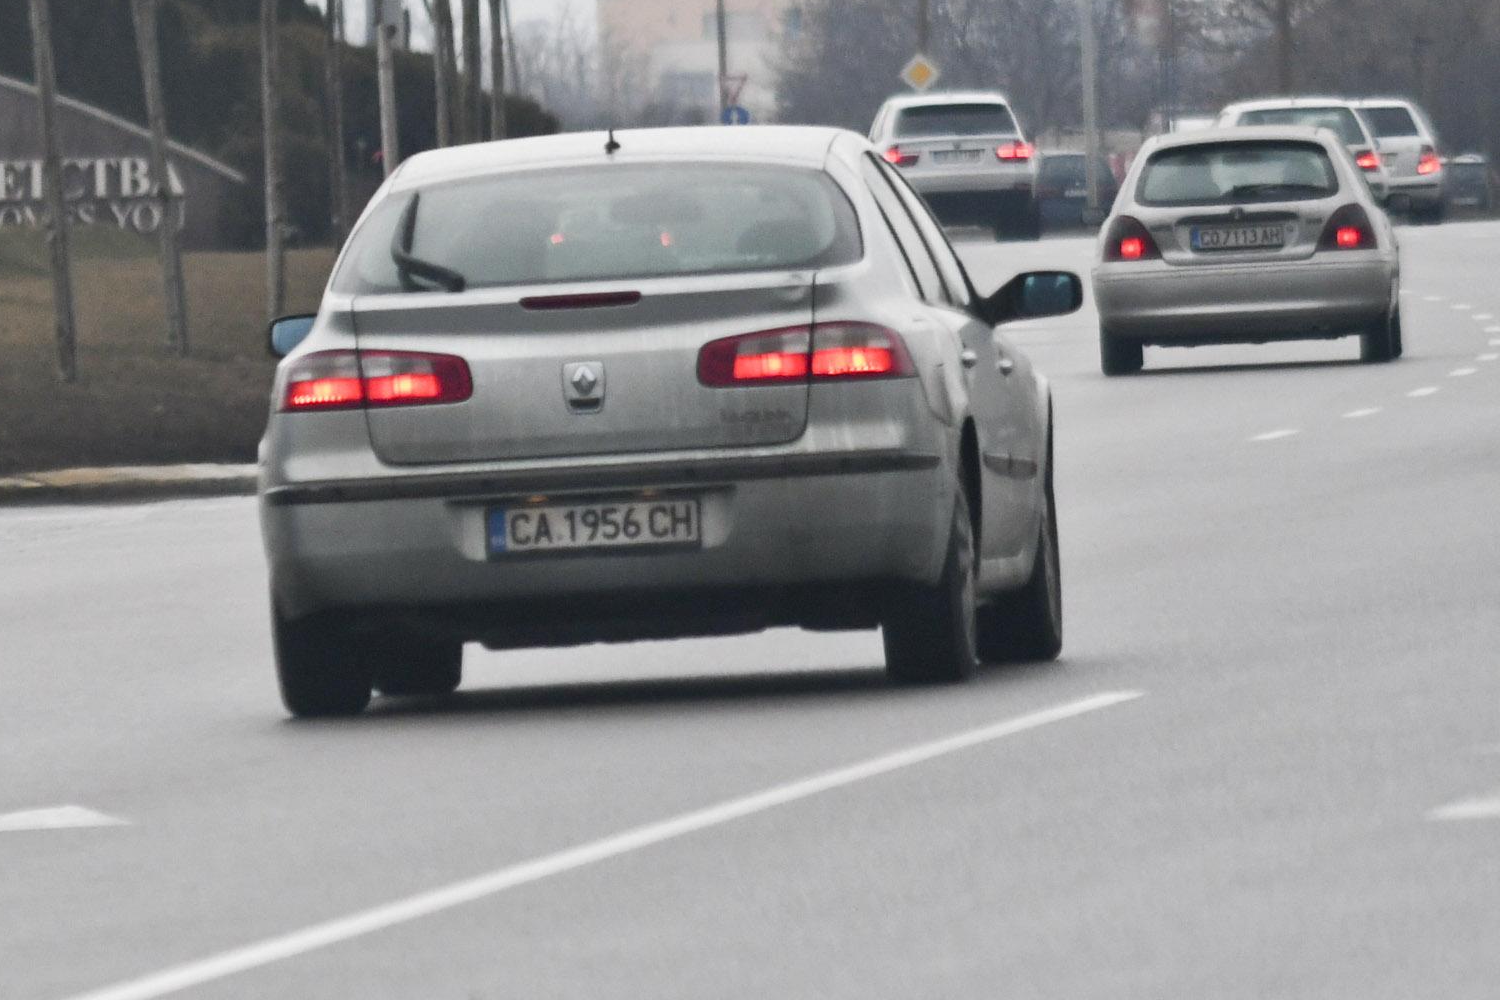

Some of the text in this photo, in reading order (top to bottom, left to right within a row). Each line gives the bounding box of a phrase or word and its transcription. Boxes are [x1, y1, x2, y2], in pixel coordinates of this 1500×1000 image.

[510, 503, 692, 546] CA 1956 CH
